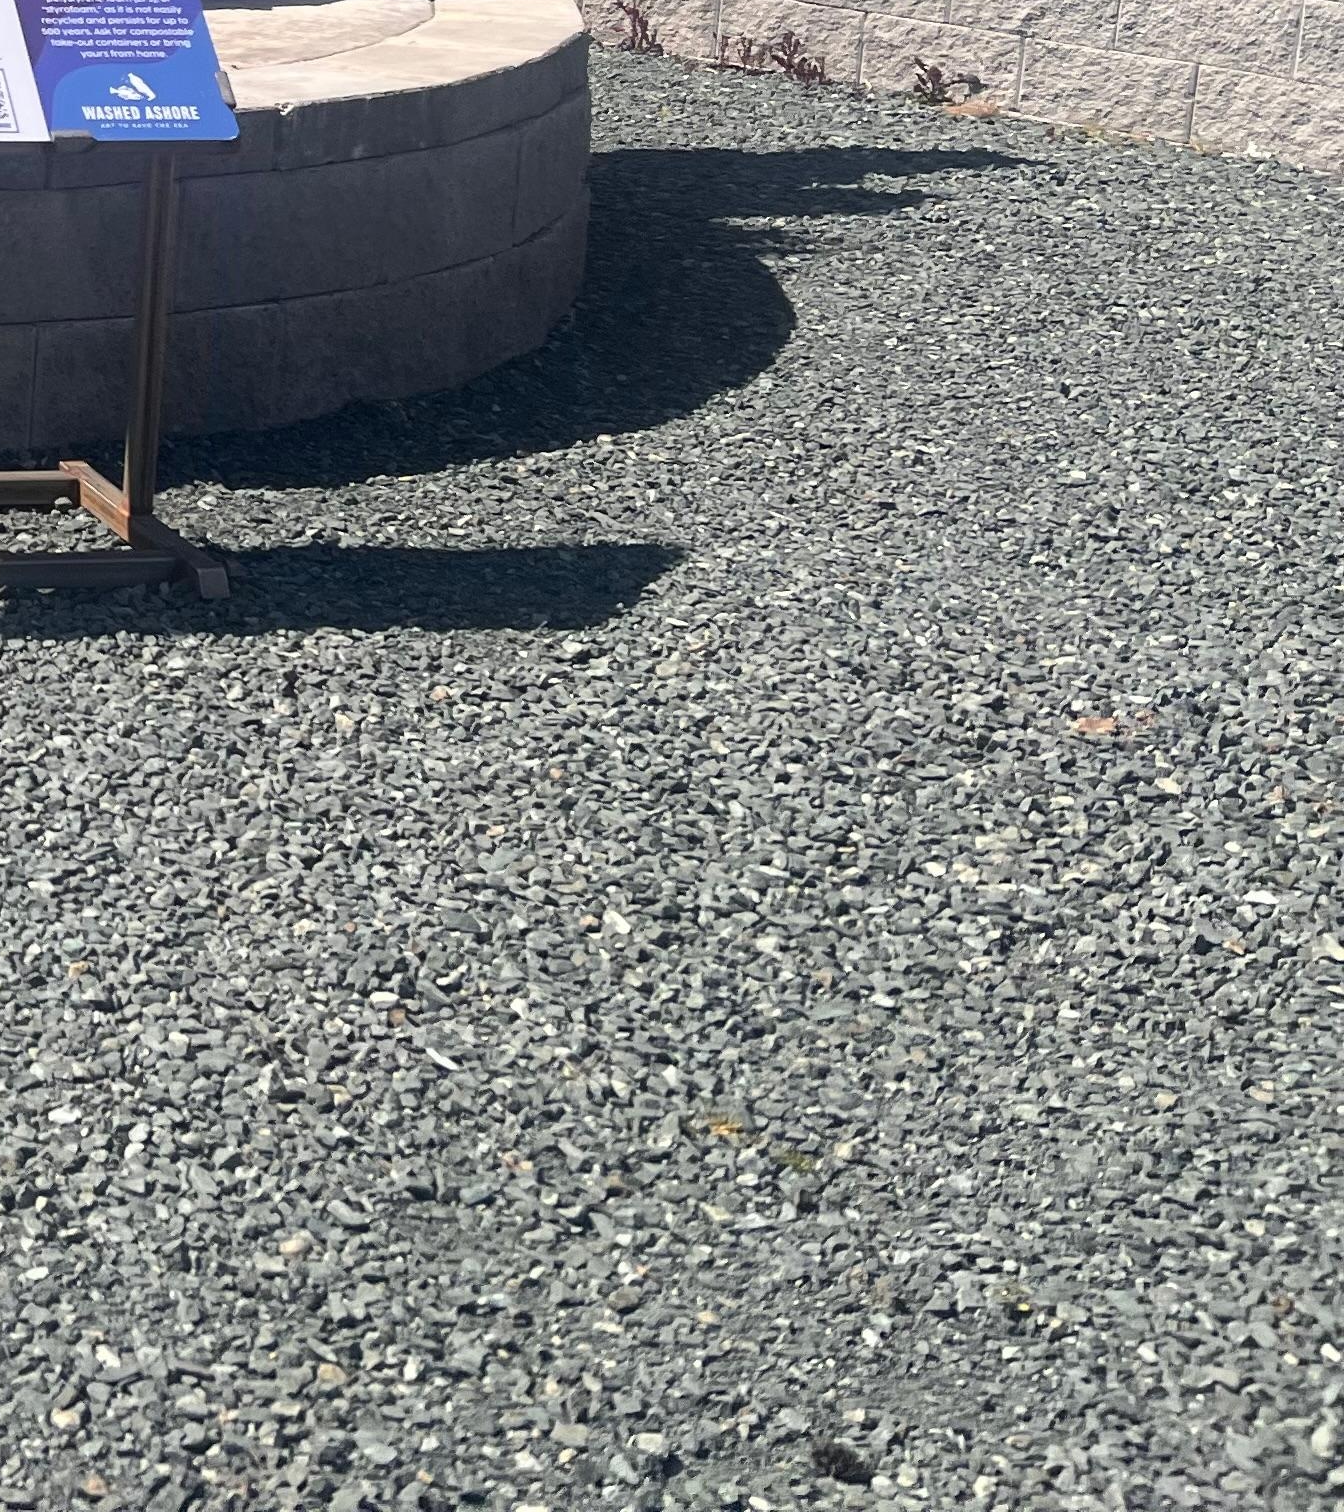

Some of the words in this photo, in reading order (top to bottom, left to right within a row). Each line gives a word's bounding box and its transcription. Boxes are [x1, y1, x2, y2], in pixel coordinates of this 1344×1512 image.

[116, 5, 124, 13] it
[153, 6, 182, 14] easily
[41, 16, 85, 25] recycled
[85, 16, 107, 24] and
[107, 17, 146, 25] persists
[145, 16, 161, 24] for
[162, 18, 177, 26] up
[177, 17, 189, 25] to
[94, 27, 112, 35] Ask
[112, 27, 127, 35] for
[95, 39, 149, 47] containers
[162, 39, 191, 48] bring
[80, 51, 110, 59] yours
[110, 49, 135, 58] from
[81, 106, 141, 120] WASHED
[145, 106, 200, 120] ASHORE
